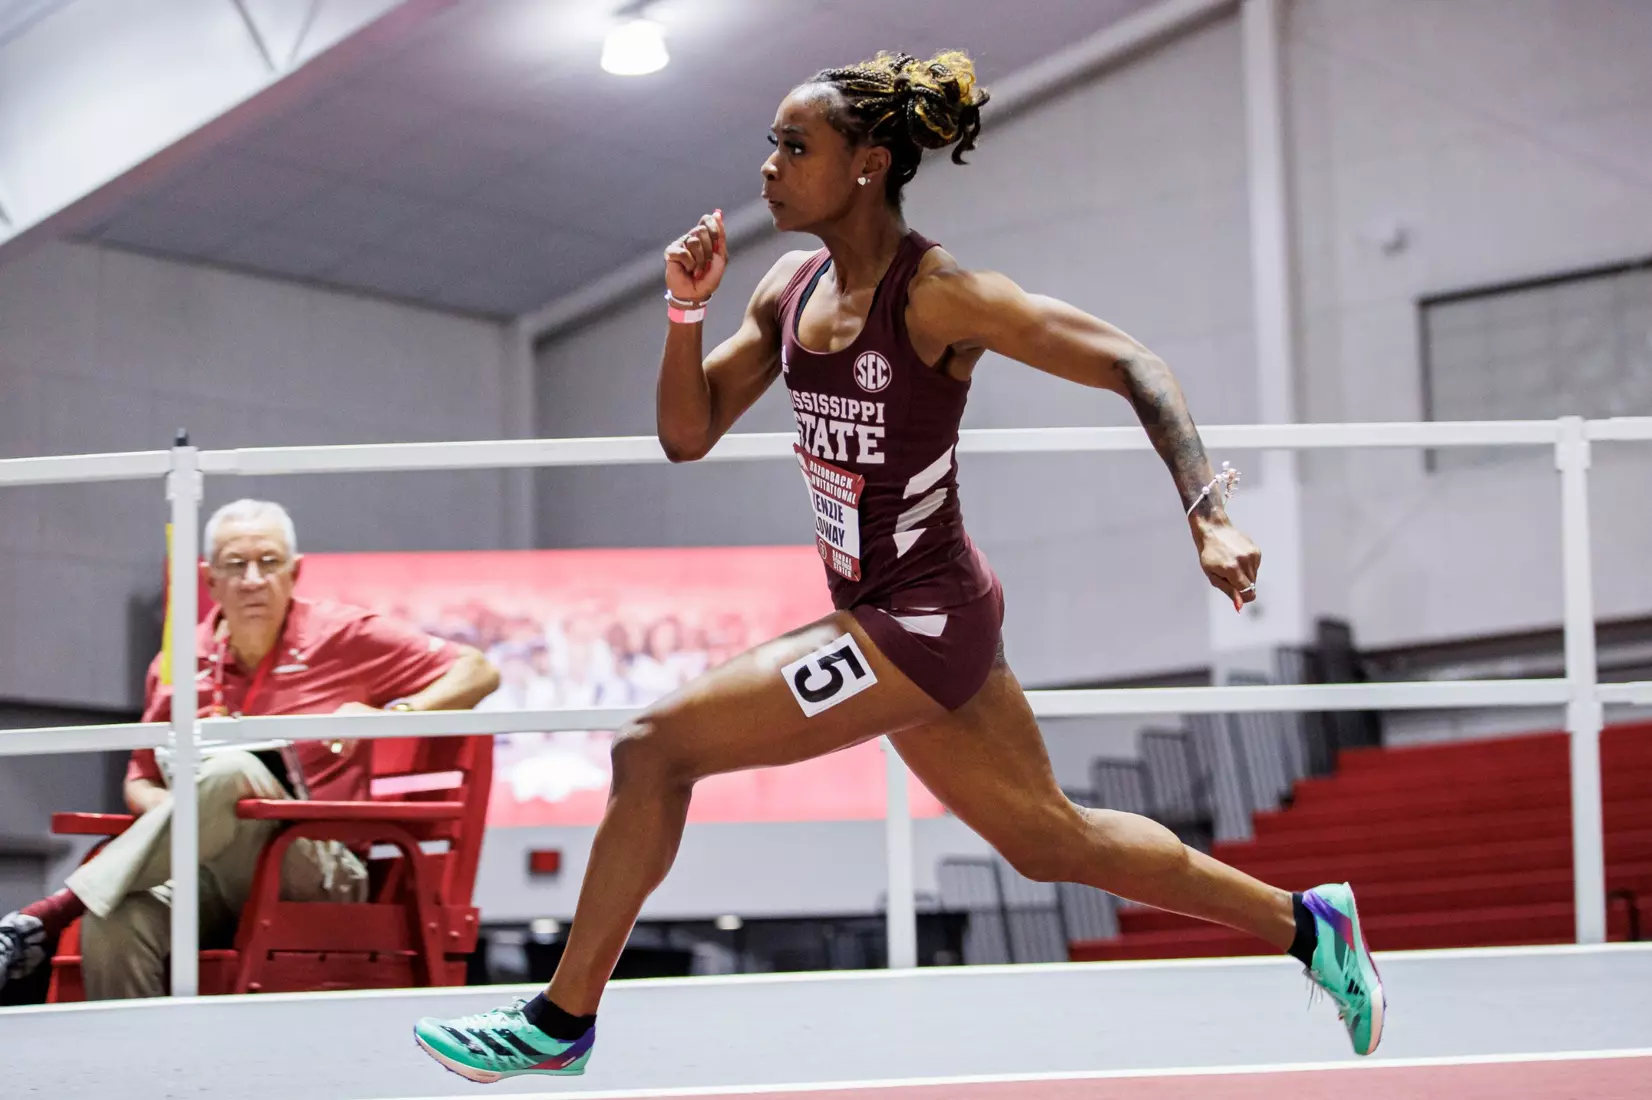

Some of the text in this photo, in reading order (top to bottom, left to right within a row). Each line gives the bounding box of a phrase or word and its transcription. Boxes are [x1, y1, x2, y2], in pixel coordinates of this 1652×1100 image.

[856, 354, 889, 390] SEC
[790, 389, 885, 424] SSISSIPPI
[809, 460, 854, 490] RAZORBACK
[811, 474, 857, 505] NVITATIONAL
[814, 493, 845, 525] ENZIE
[794, 645, 866, 703] 5
